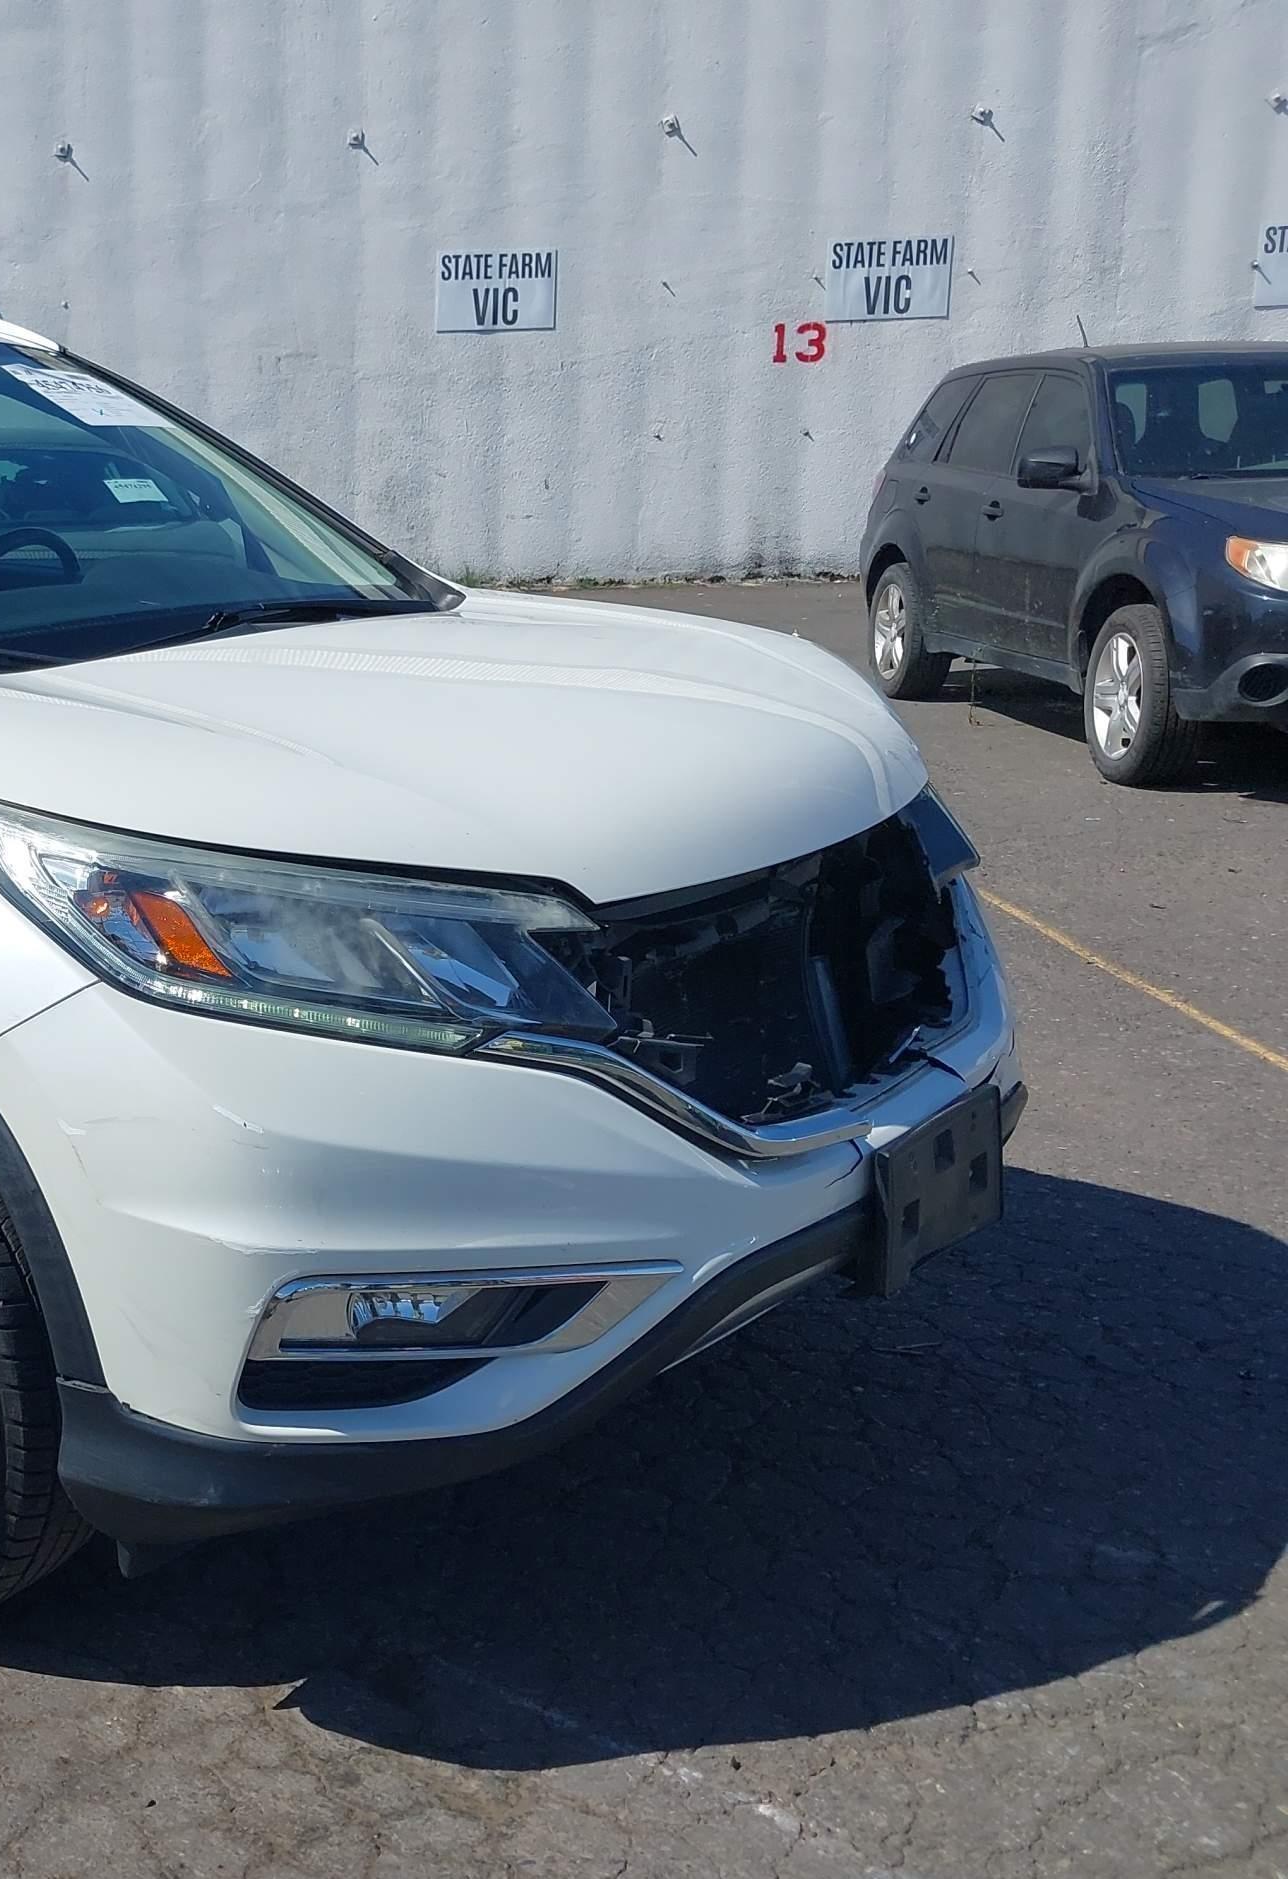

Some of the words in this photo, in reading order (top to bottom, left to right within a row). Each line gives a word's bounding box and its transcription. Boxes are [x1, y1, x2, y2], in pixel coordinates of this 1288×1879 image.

[441, 254, 493, 281] STATE
[498, 252, 552, 279] FARM
[831, 241, 886, 269] STATE
[892, 238, 949, 266] FARM
[472, 287, 519, 326] VIC
[864, 275, 912, 315] VIC
[773, 321, 827, 363] 13
